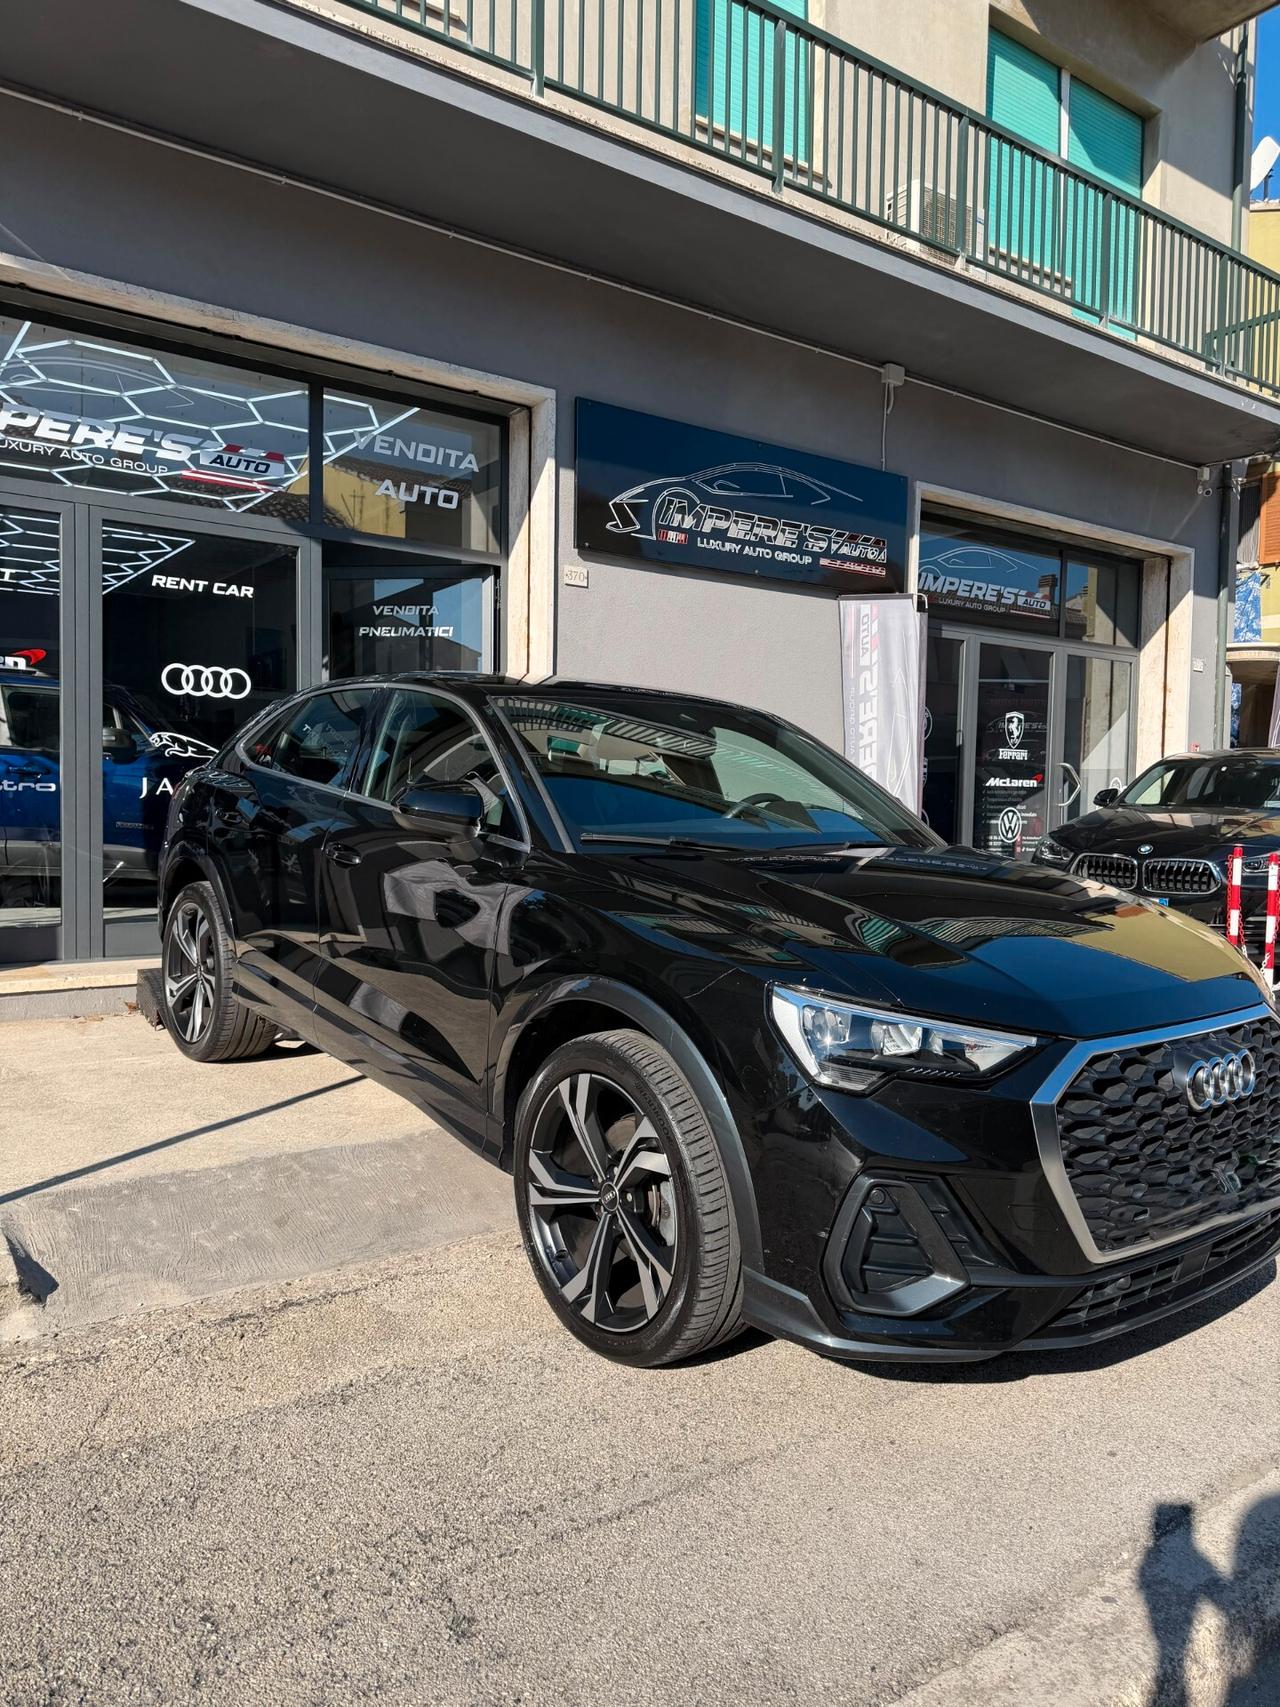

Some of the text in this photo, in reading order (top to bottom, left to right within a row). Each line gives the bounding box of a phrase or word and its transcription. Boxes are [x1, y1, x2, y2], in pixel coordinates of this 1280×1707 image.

[353, 430, 479, 472] VENDITA
[60, 449, 104, 465] AUTO
[110, 457, 168, 475] GROUP
[208, 453, 272, 475] AUTO
[375, 479, 459, 509] AUTO
[697, 537, 812, 565] LUXURY AUTO GROUP
[151, 574, 254, 598] RENT CAR
[372, 605, 440, 616] VENDITA
[939, 598, 1006, 613] LUXURY AUTO GROUP
[1022, 597, 1047, 609] AUTO
[358, 626, 454, 638] PNEUMATICI
[998, 748, 1028, 761] Ferrari
[985, 777, 1038, 788] McLaren
